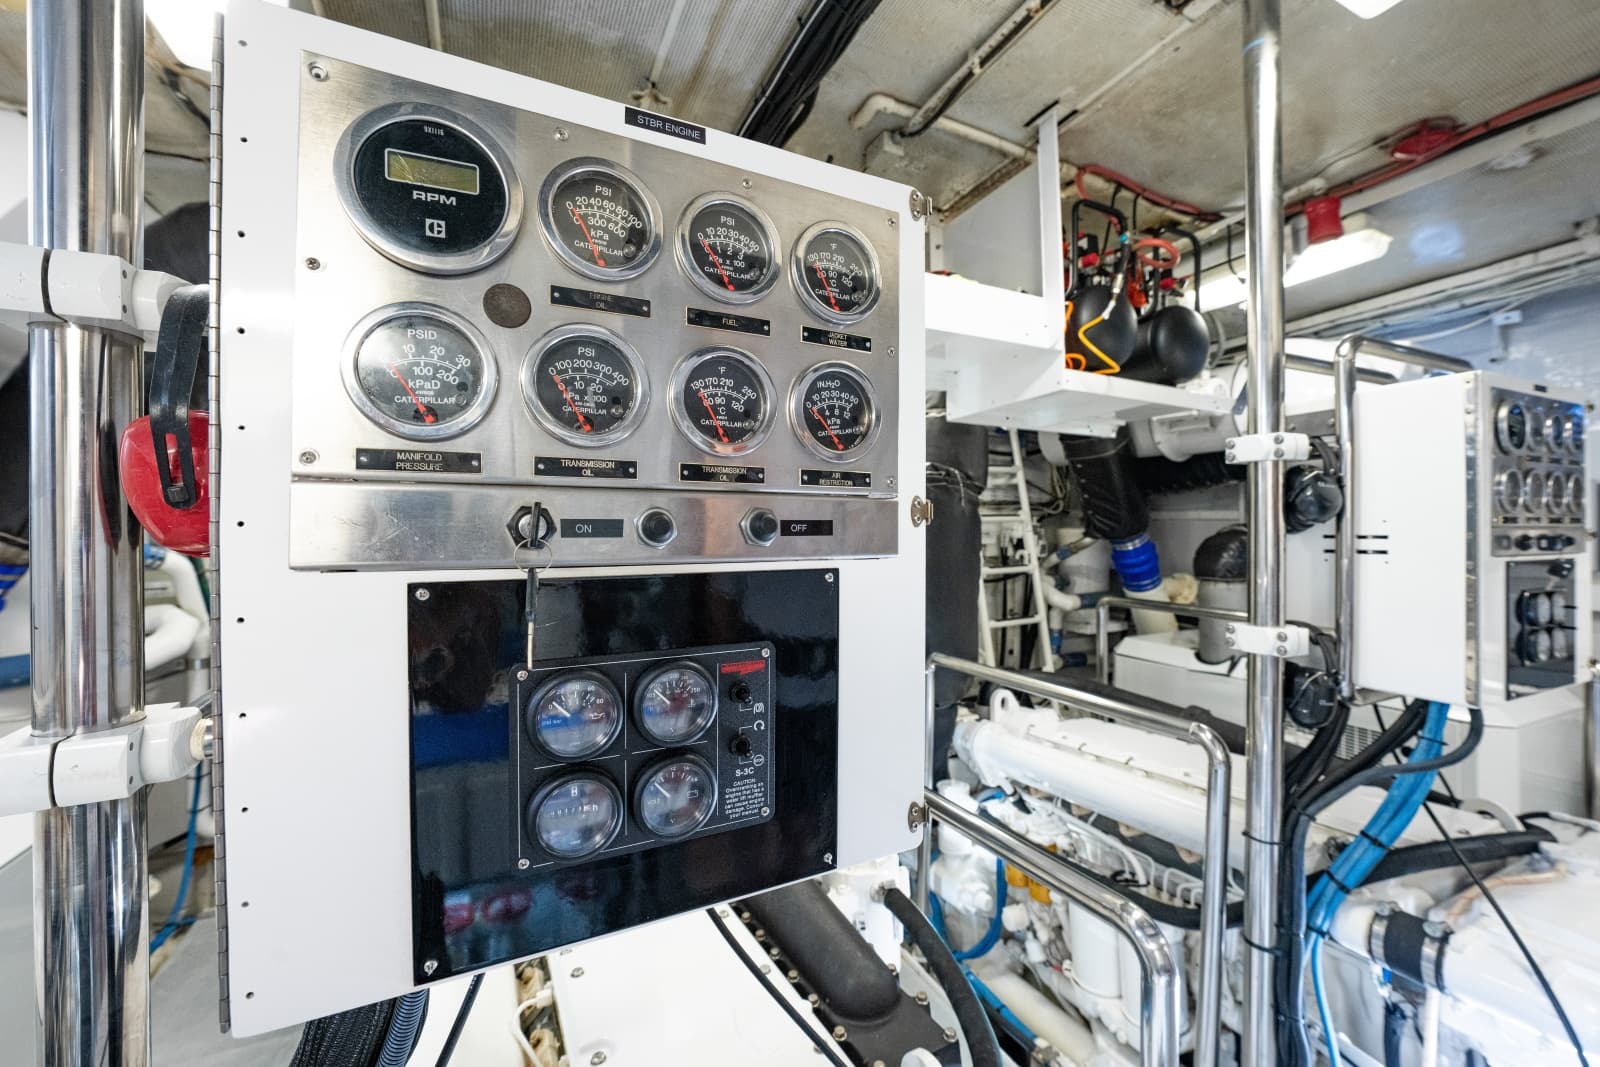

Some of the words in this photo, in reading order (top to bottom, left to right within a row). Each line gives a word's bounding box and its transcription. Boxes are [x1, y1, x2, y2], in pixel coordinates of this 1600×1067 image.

[637, 115, 663, 129] STBR
[665, 123, 701, 139] ENGINE
[595, 185, 612, 196] PSI
[412, 190, 457, 206] RPM
[566, 201, 574, 209] 0
[576, 196, 588, 205] 20
[589, 197, 602, 206] 40
[603, 200, 616, 211] 60
[615, 206, 629, 217] 80
[629, 215, 642, 229] 100
[721, 216, 735, 226] PSI
[588, 217, 607, 227] 300
[608, 224, 626, 238] 600
[591, 229, 609, 241] kPa
[698, 232, 704, 240] 0
[706, 227, 715, 235] 10
[717, 227, 728, 235] 20
[728, 229, 739, 239] 30
[739, 234, 750, 244] 40
[728, 248, 733, 256] 2
[807, 253, 819, 262] 130
[819, 252, 831, 260] 170
[832, 254, 845, 263] 210
[734, 260, 745, 268] 100
[829, 271, 838, 279] 90
[841, 276, 853, 287] 120
[722, 318, 738, 327] FUEL
[407, 329, 437, 340] PSID
[828, 338, 848, 347] WATER
[403, 344, 416, 353] 10
[430, 346, 445, 356] 20
[456, 354, 471, 367] 30
[578, 347, 595, 357] PSI
[412, 366, 433, 376] 100
[436, 370, 459, 385] 200
[548, 367, 557, 376] 0
[555, 360, 572, 371] 100
[574, 360, 593, 368] 200
[593, 362, 612, 375] 300
[612, 372, 629, 386] 400
[408, 379, 441, 389] kPaD
[574, 381, 585, 390] 10
[591, 384, 603, 393] 20
[691, 380, 704, 390] 130
[705, 377, 718, 385] 170
[720, 378, 734, 387] 210
[394, 396, 456, 405] CATERPILLAR
[593, 395, 607, 403] 100
[821, 391, 830, 399] 20
[840, 392, 850, 400] 40
[715, 397, 726, 405] 90
[731, 401, 744, 413] 120
[397, 452, 443, 462] MANIFOLD
[396, 462, 443, 471] PRESSURE
[561, 460, 615, 468] TRANSMISSION
[702, 466, 747, 474] TRANSMISSION
[575, 524, 592, 534] ON
[790, 524, 808, 533] OFF
[736, 767, 754, 777] S-3C
